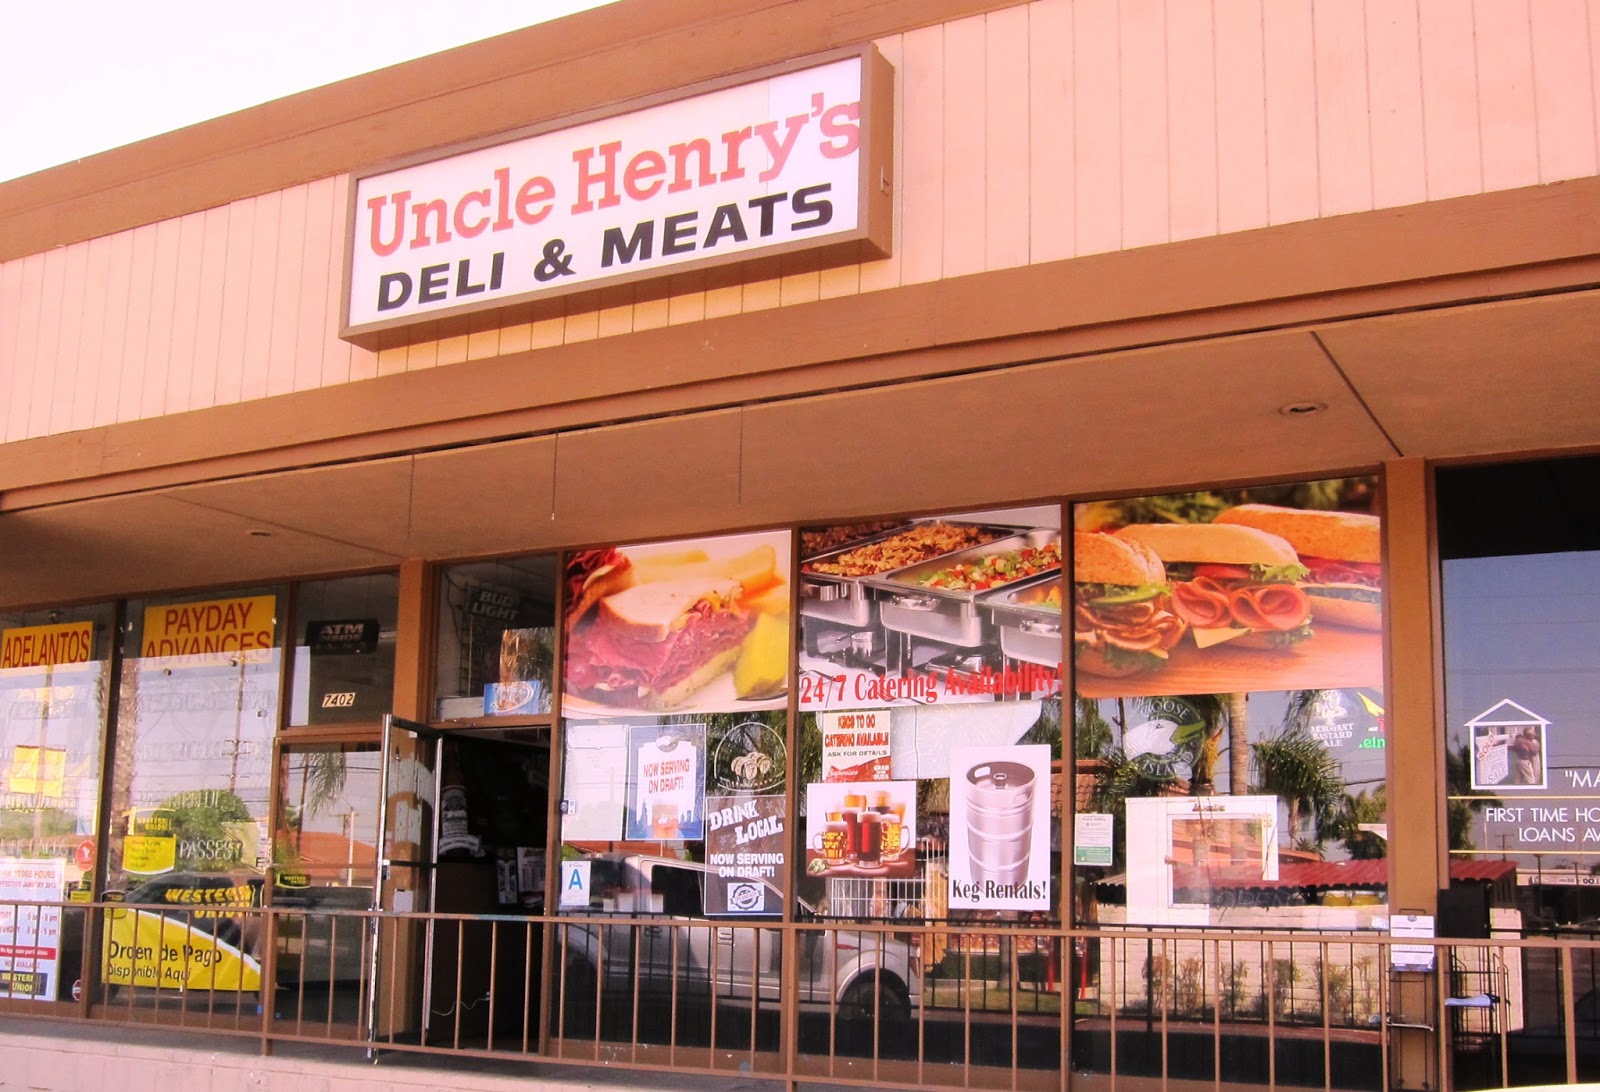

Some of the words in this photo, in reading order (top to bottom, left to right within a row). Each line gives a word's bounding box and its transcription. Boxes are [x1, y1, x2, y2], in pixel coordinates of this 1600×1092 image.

[367, 166, 556, 257] Uncle
[571, 92, 860, 215] Henry's
[377, 251, 504, 312] DELI
[533, 238, 576, 282] &
[600, 182, 834, 268] MEATS
[480, 591, 512, 606] BUD
[165, 602, 253, 635] PAYDAY
[472, 602, 519, 620] LIGHT
[320, 624, 364, 635] ATM
[2, 630, 90, 668] ADELANTOS
[145, 631, 271, 664] ADVANCES
[801, 674, 846, 708] 24/7
[855, 667, 938, 703] Catering
[944, 662, 1062, 698] Availability!
[324, 694, 354, 706] 7402
[856, 714, 864, 728] TO
[1312, 731, 1352, 740] BASTARD
[1323, 739, 1343, 747] ALE
[643, 763, 659, 778] NOW
[661, 758, 689, 776] SERVING
[649, 779, 659, 794] ON
[660, 776, 684, 792] DRAFT!
[709, 799, 760, 831] DRINK
[1485, 808, 1524, 822] FIRST
[1530, 808, 1568, 822] TIME
[735, 815, 784, 845] LOCAL
[1519, 827, 1576, 842] LOANS
[710, 854, 734, 865] NOW
[737, 853, 784, 865] SERVING
[568, 869, 583, 890] A
[719, 866, 734, 878] ON
[737, 866, 775, 878] DRAFT!
[165, 885, 252, 903] WESTERN
[952, 879, 980, 903] Keg
[985, 880, 1046, 899] Rentals!
[161, 944, 178, 961] de
[182, 944, 222, 967] Pago
